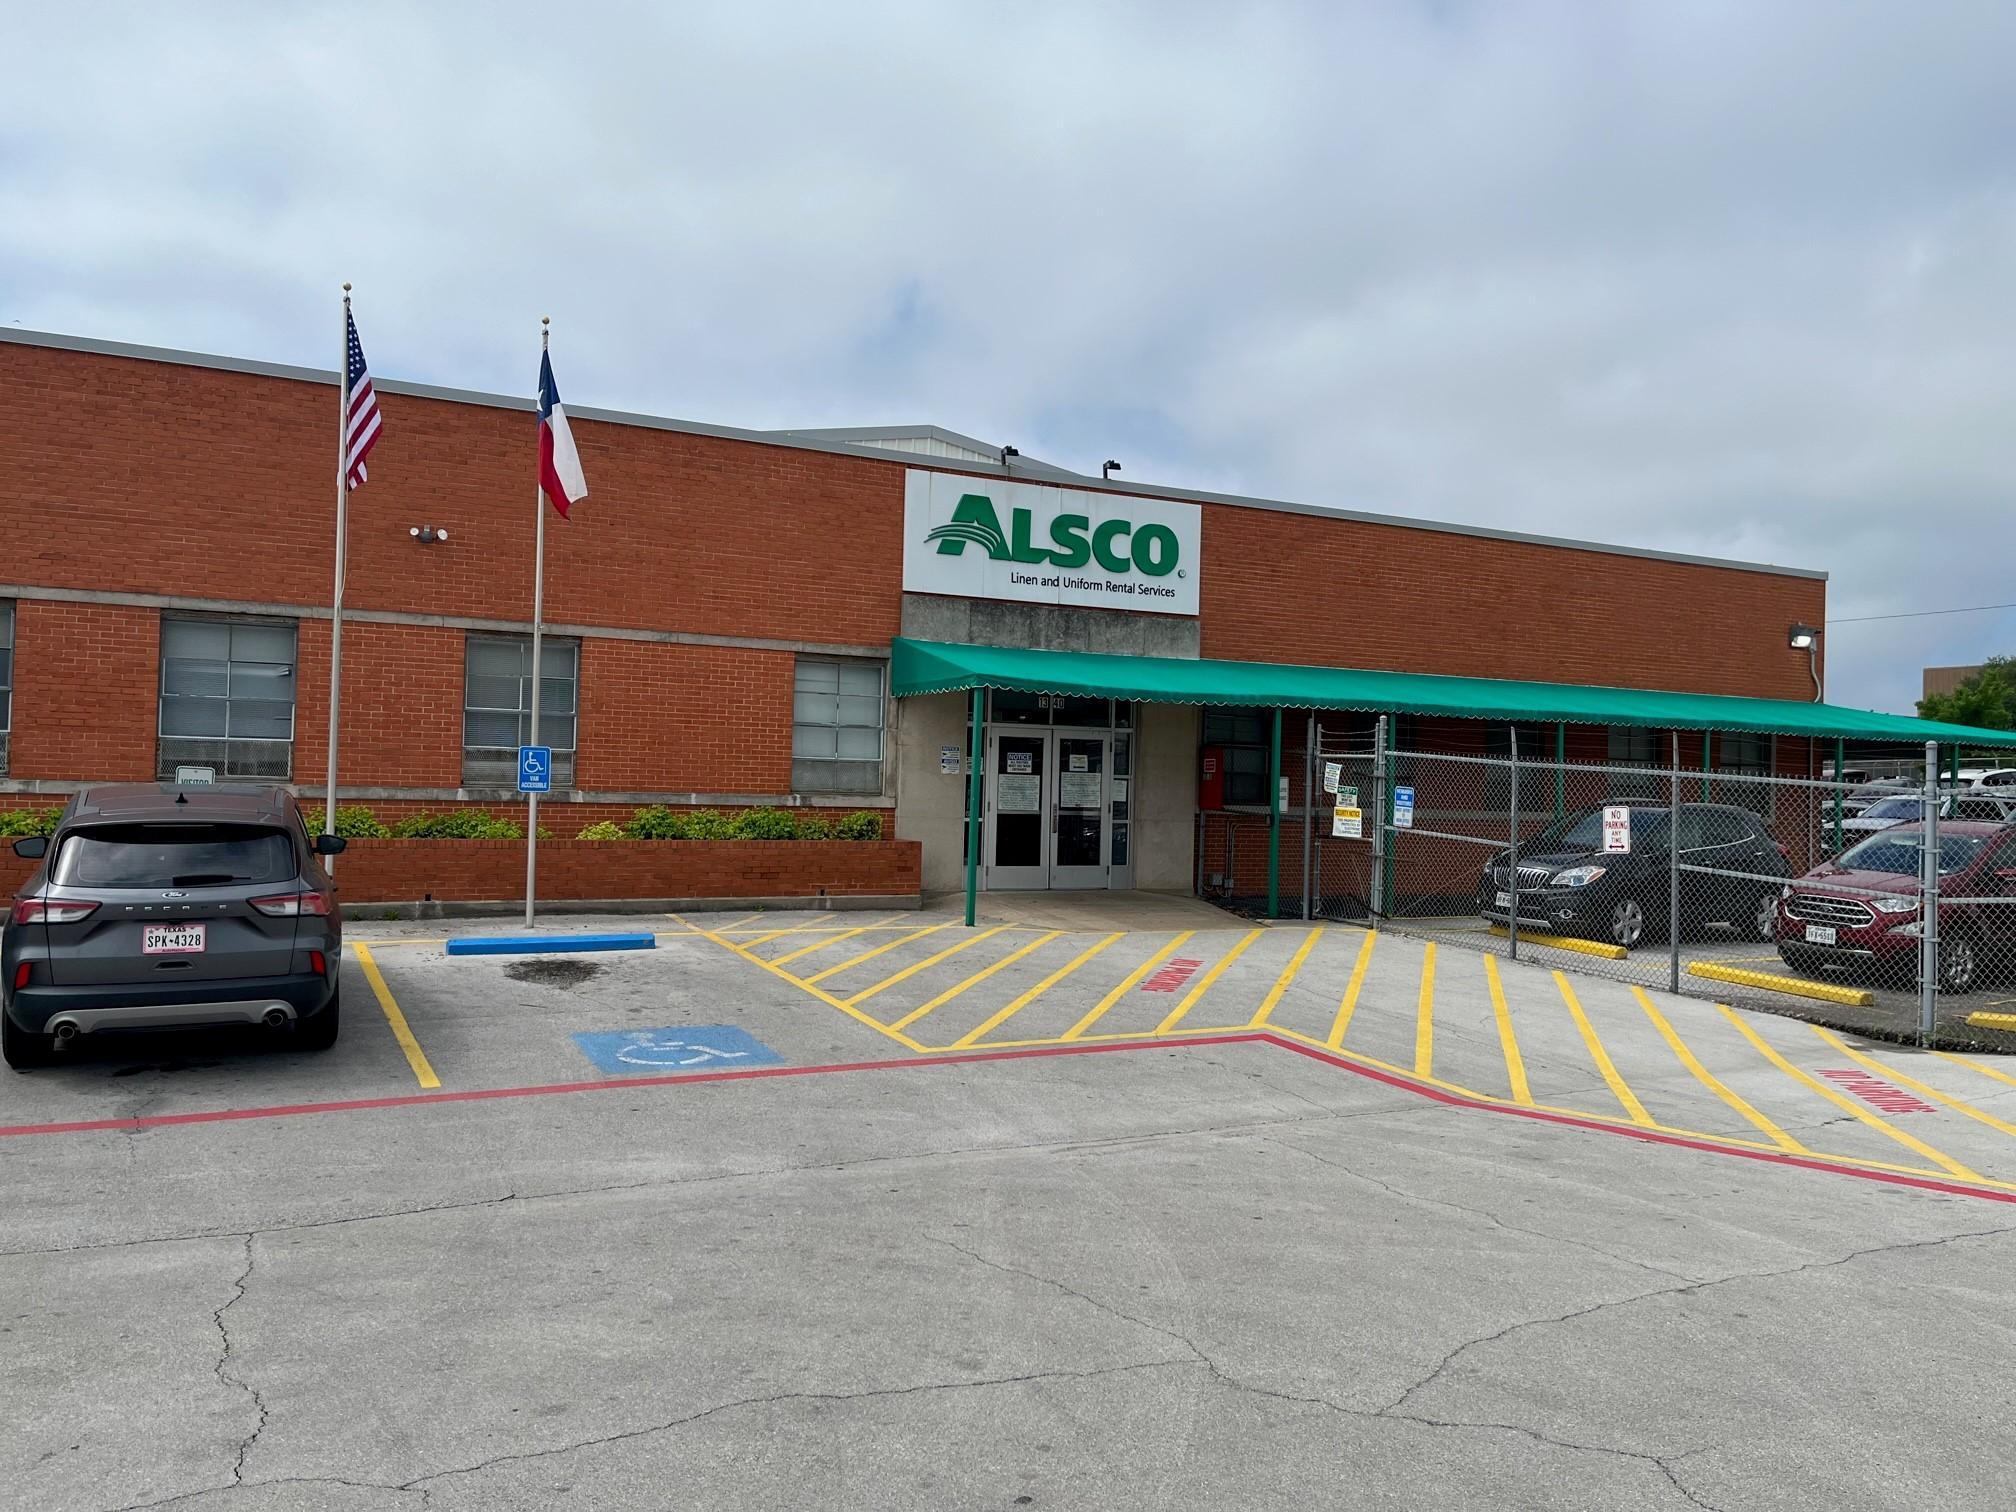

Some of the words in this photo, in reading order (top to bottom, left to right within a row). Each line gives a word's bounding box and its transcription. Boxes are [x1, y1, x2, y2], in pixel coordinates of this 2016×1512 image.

[925, 493, 1179, 577] ALSCO
[1010, 572, 1038, 586] Linen
[1041, 575, 1060, 588] and
[1063, 577, 1103, 591] Uniform
[1105, 581, 1136, 594] Rental
[1138, 584, 1176, 598] Services
[1009, 752, 1031, 761] NOTICE
[1611, 810, 1621, 819] NO
[1605, 821, 1628, 829] PARKING
